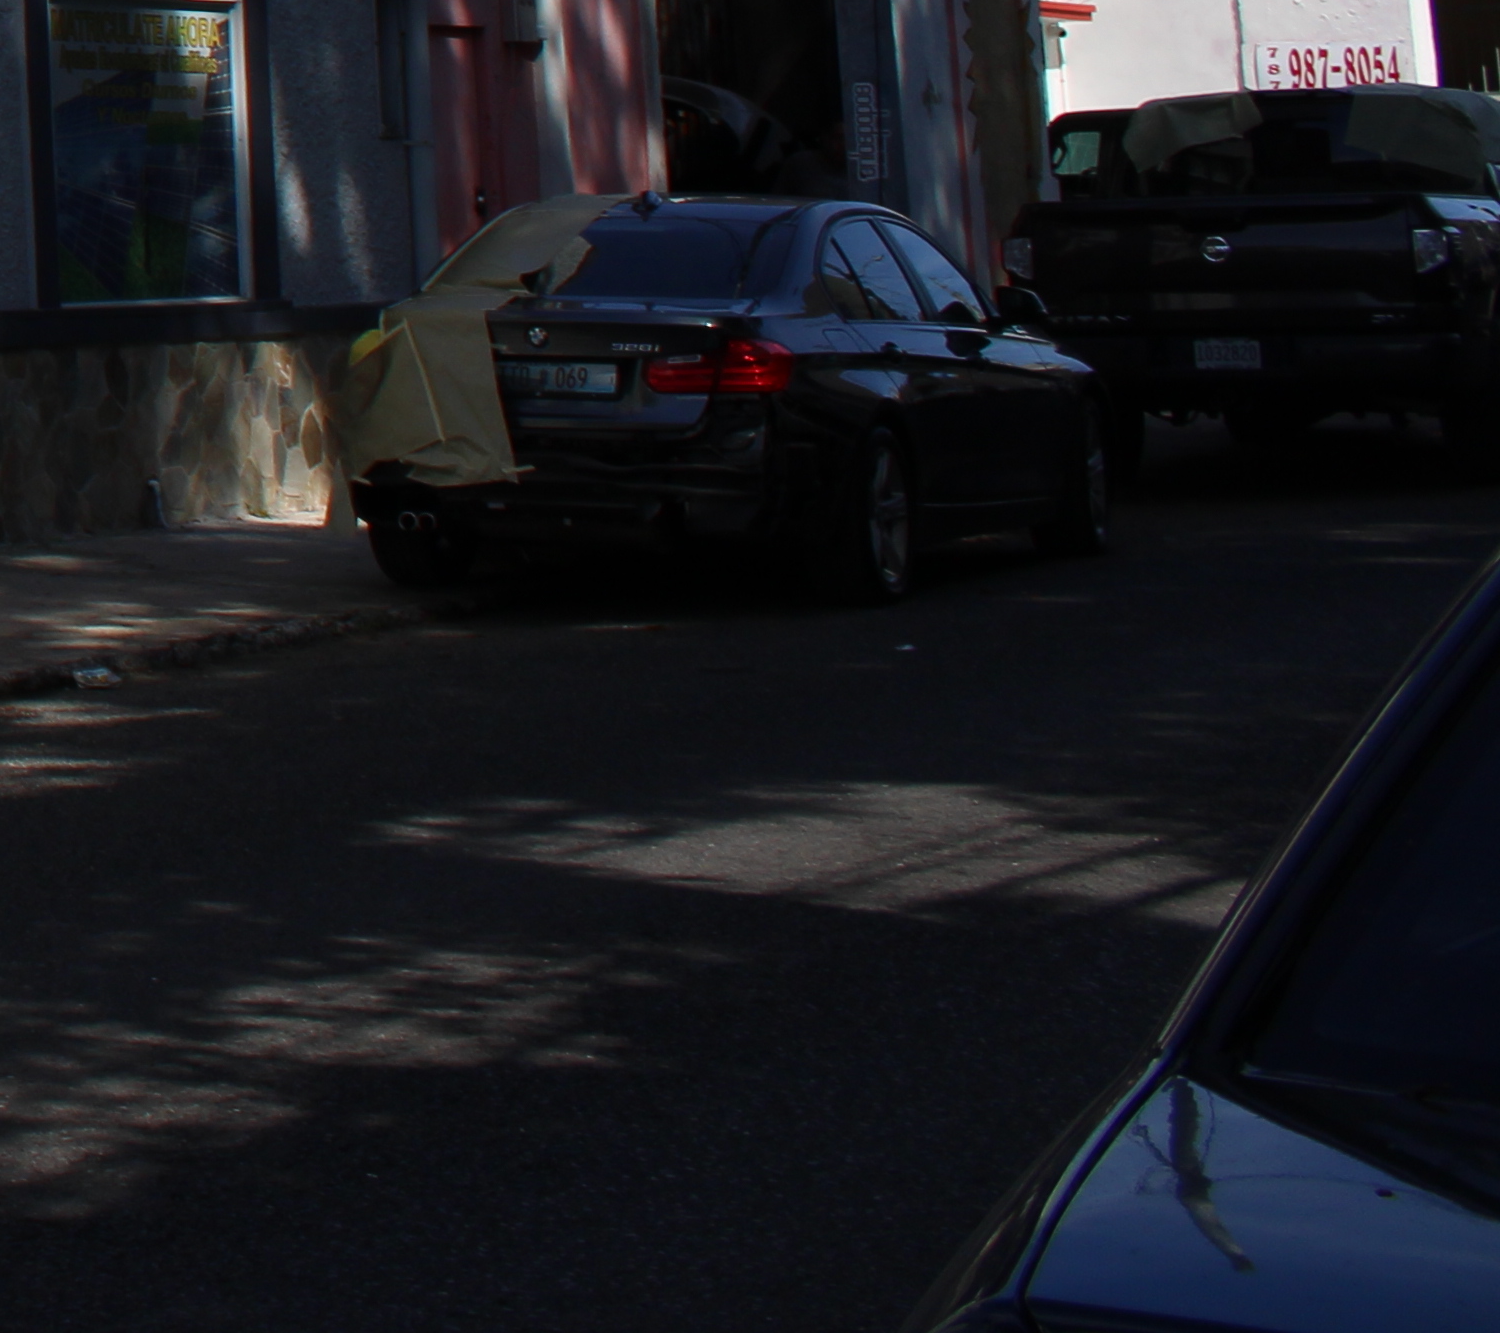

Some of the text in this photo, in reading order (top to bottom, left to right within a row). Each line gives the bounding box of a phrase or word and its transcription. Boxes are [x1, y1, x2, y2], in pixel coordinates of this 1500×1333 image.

[50, 9, 221, 48] MATRICULATE AHORA
[1289, 46, 1400, 89] 987-8054
[555, 367, 588, 389] 069
